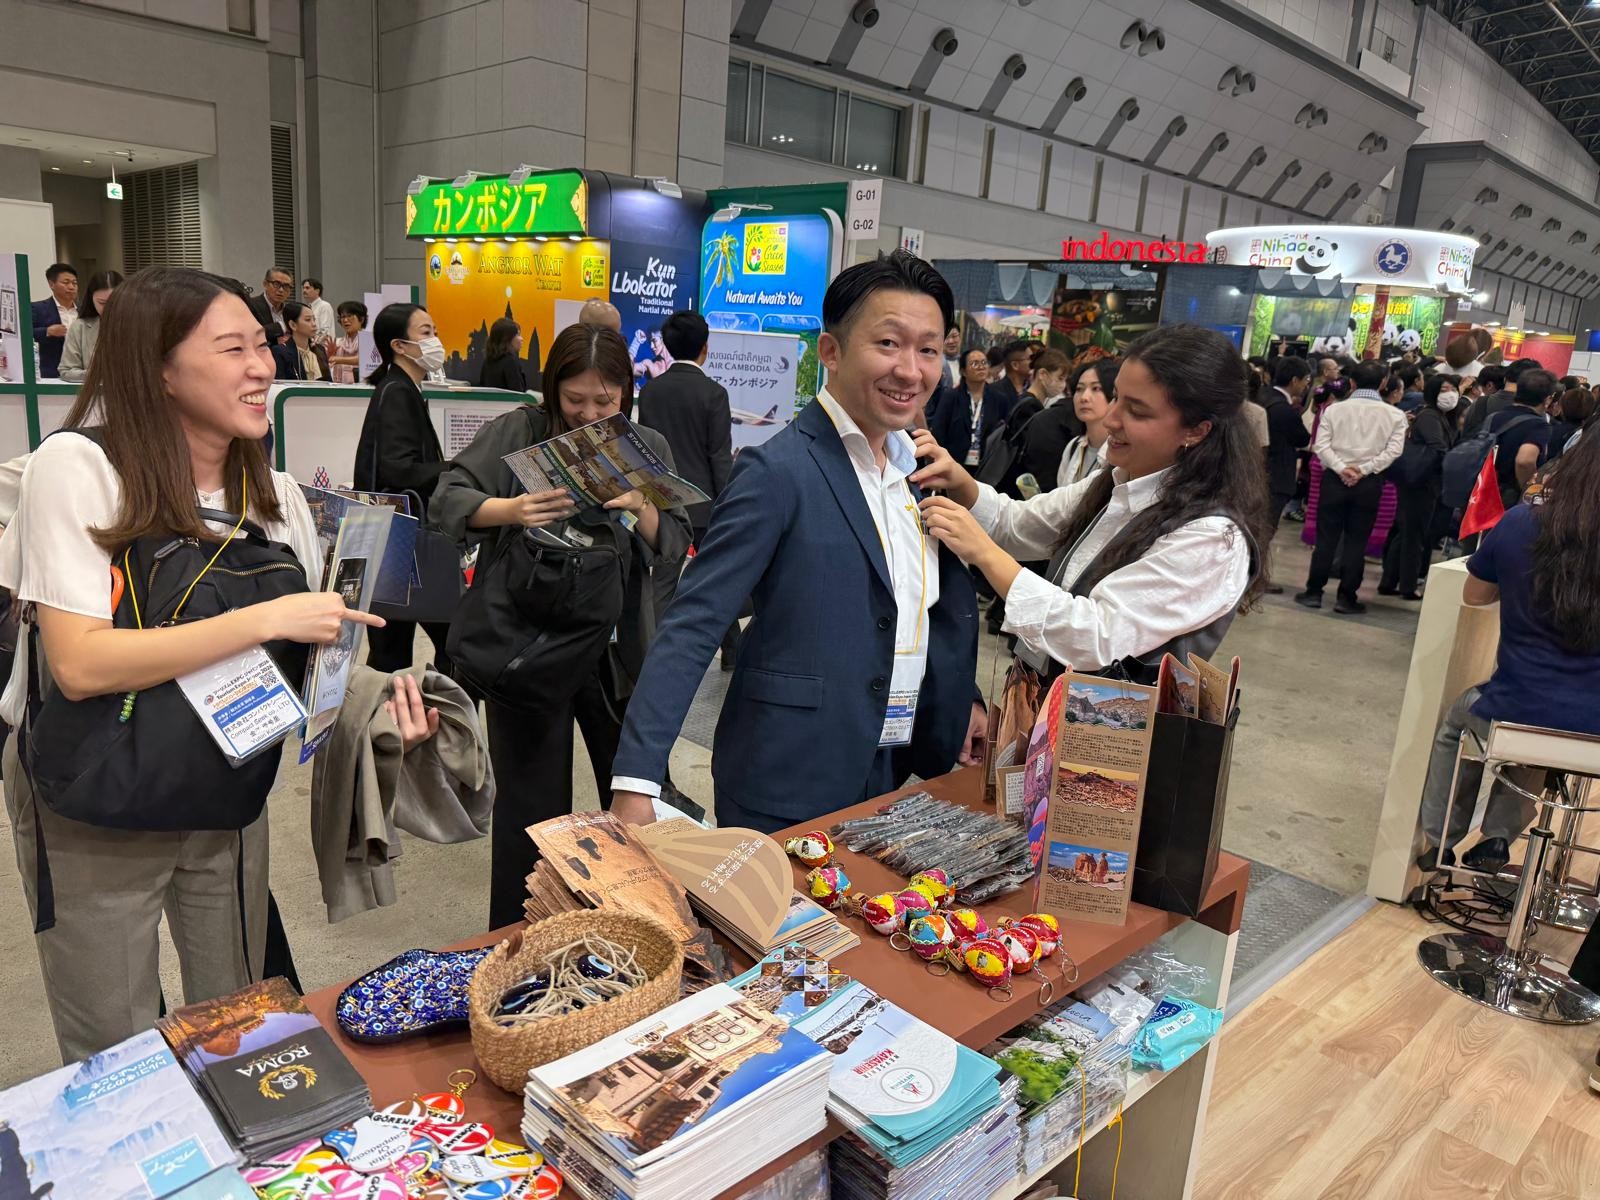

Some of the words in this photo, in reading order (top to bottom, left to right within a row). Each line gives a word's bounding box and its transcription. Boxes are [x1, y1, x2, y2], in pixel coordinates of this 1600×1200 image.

[856, 190, 876, 201] G-01
[433, 182, 548, 233] カンボジア
[853, 219, 874, 230] G-02
[1061, 230, 1208, 263] indonesia
[1262, 238, 1308, 252] Nihao
[478, 255, 533, 275] ANGKOR
[534, 254, 563, 276] WAT
[646, 256, 676, 279] Kun
[1249, 253, 1293, 267] China
[1437, 262, 1464, 278] China
[611, 271, 677, 298] Lbokator
[641, 297, 673, 307] Traditional
[725, 290, 756, 304] Natural
[757, 290, 786, 305] Awaits
[787, 291, 803, 306] You
[638, 305, 660, 315] Martial
[660, 308, 673, 316] Arts
[708, 362, 723, 370] AIR
[724, 363, 771, 373] CAMBODIA
[709, 375, 778, 389] ア・カンボジア
[627, 432, 643, 448] STAR
[641, 447, 657, 464] WARS
[701, 840, 750, 888] 文化に触れる
[709, 838, 765, 894] 歴史を探求する
[91, 1053, 164, 1090] ランドへようこそ
[235, 1045, 312, 1077] ROMA
[369, 1144, 405, 1167] Capital
